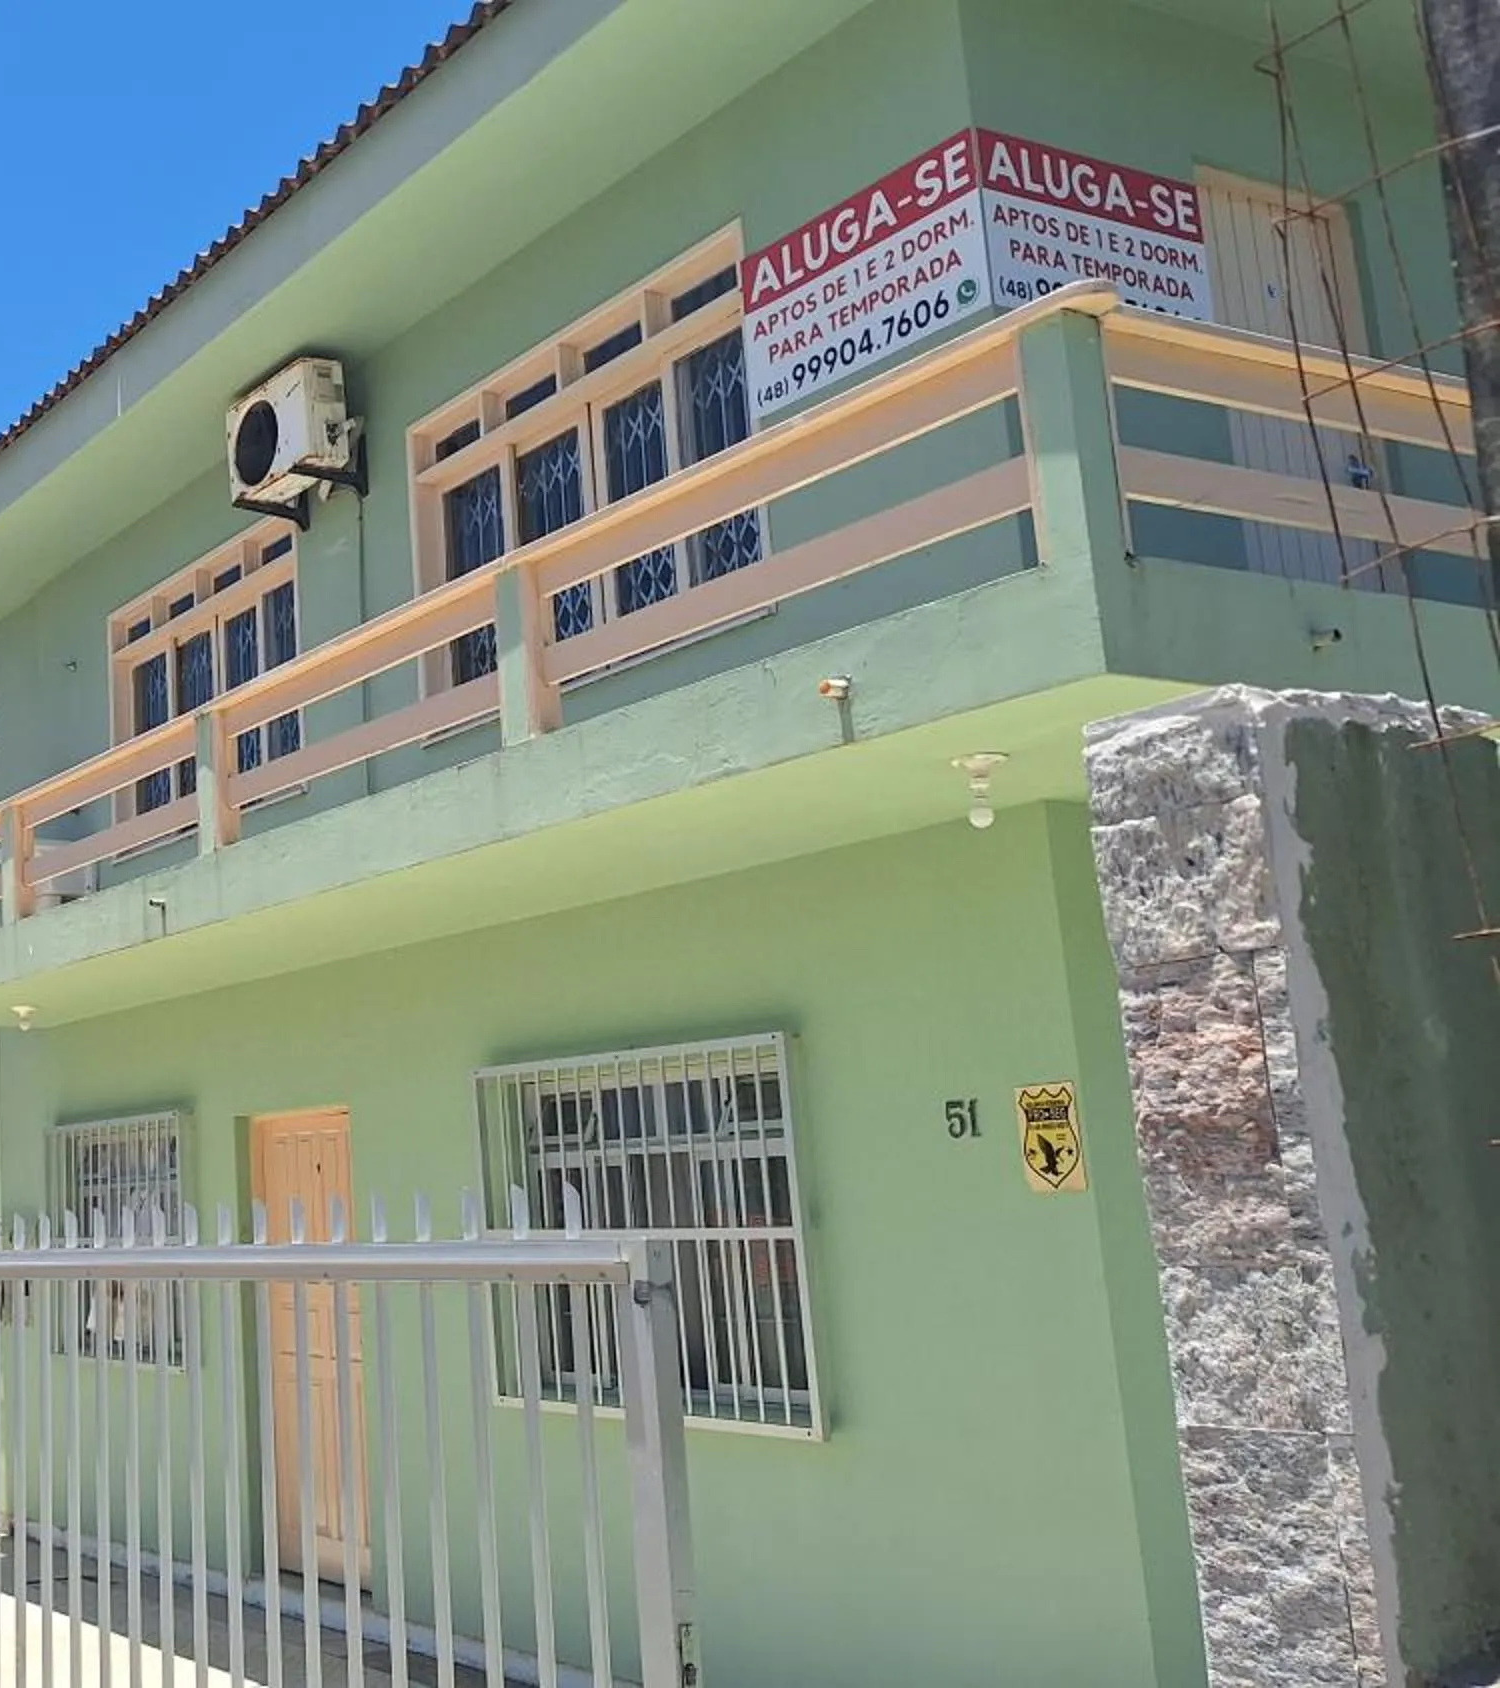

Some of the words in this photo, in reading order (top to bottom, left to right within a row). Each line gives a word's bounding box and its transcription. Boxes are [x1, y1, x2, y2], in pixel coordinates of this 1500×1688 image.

[751, 140, 971, 304] ALUGA-SE
[988, 141, 1198, 233] ALUGA-SE
[753, 292, 817, 341] APTOS
[823, 276, 847, 304] DE
[853, 268, 861, 287] 1
[867, 258, 878, 281] E
[884, 250, 896, 271] 2
[901, 208, 975, 262] DORM.
[993, 204, 1060, 238] APTOS
[1066, 222, 1090, 246] DE
[1095, 229, 1103, 247] 1
[1109, 233, 1120, 252] E
[1125, 238, 1136, 257] 2
[1140, 239, 1204, 273] DORM.
[1009, 239, 1067, 271] PARA
[1072, 253, 1194, 301] TEMPORADA
[768, 322, 824, 364] PARA
[828, 248, 962, 332] TEMPORADA
[1000, 276, 1032, 301] (48)
[757, 376, 789, 406] (48)
[791, 290, 950, 389] 99904.7606
[945, 1099, 981, 1138] 51
